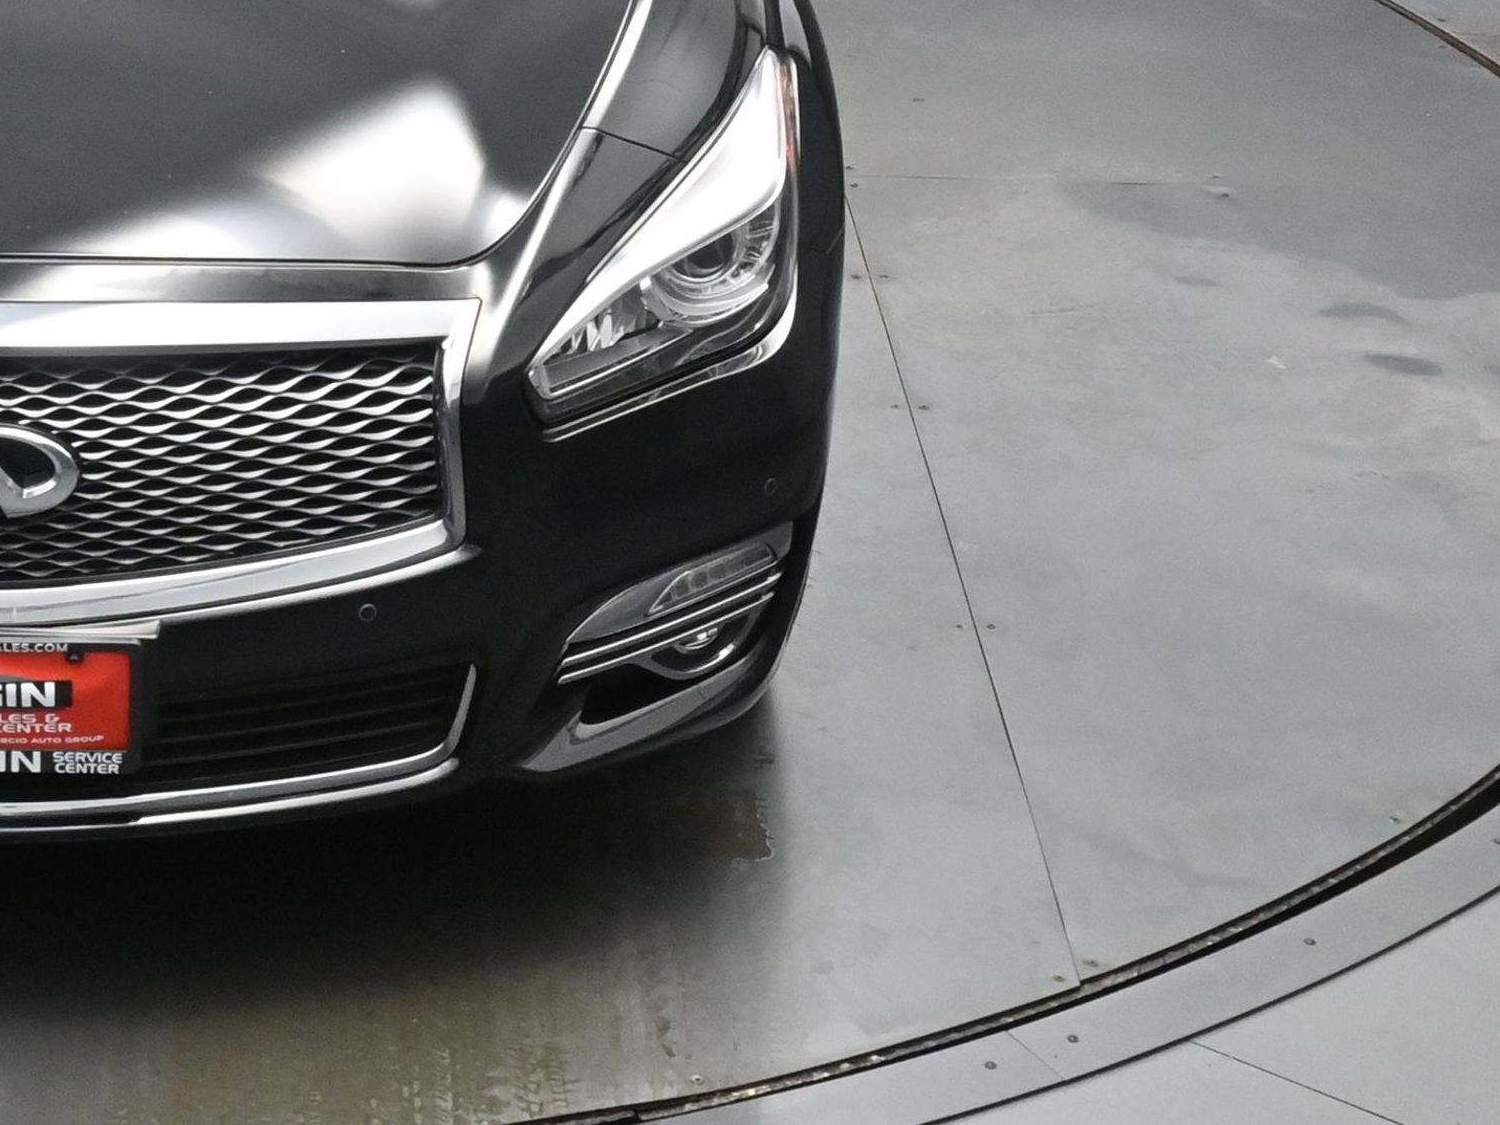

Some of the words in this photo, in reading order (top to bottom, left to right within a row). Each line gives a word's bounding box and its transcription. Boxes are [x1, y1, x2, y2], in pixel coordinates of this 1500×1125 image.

[31, 736, 62, 745] AUTO
[65, 735, 105, 744] GROUP
[52, 751, 123, 764] SERVICE
[54, 762, 120, 775] CENTER
